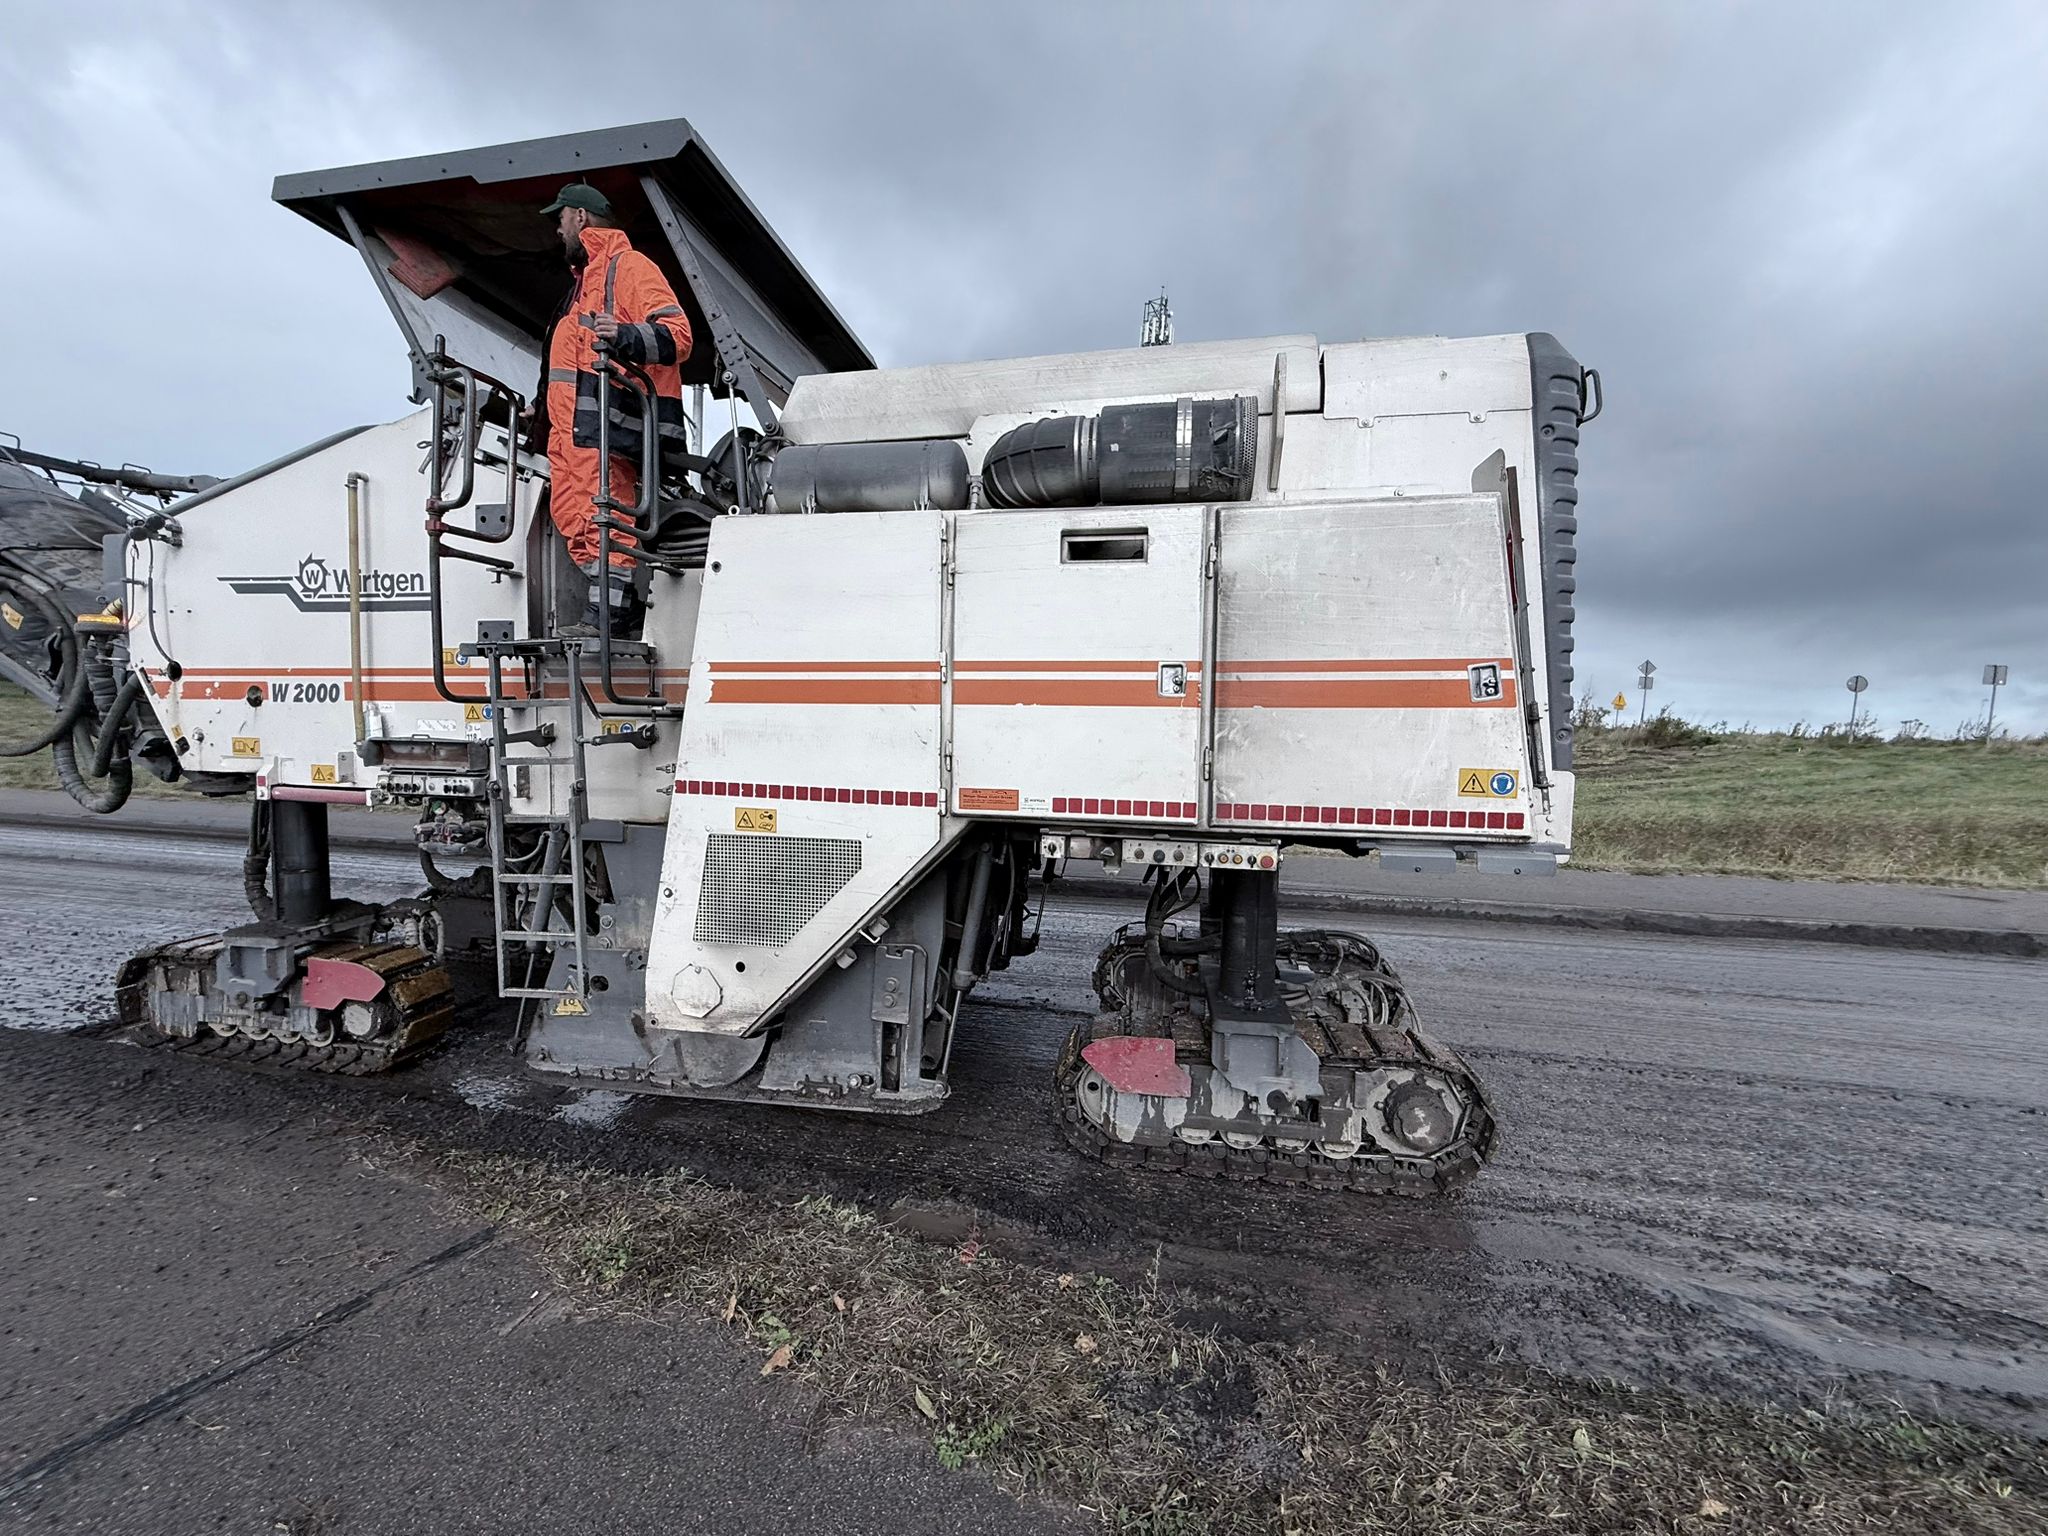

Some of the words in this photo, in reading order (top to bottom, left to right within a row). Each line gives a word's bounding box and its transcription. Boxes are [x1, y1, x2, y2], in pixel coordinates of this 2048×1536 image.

[305, 569, 320, 585] W
[332, 569, 424, 598] Wirtgen
[272, 683, 289, 703] W
[293, 683, 340, 703] 2000
